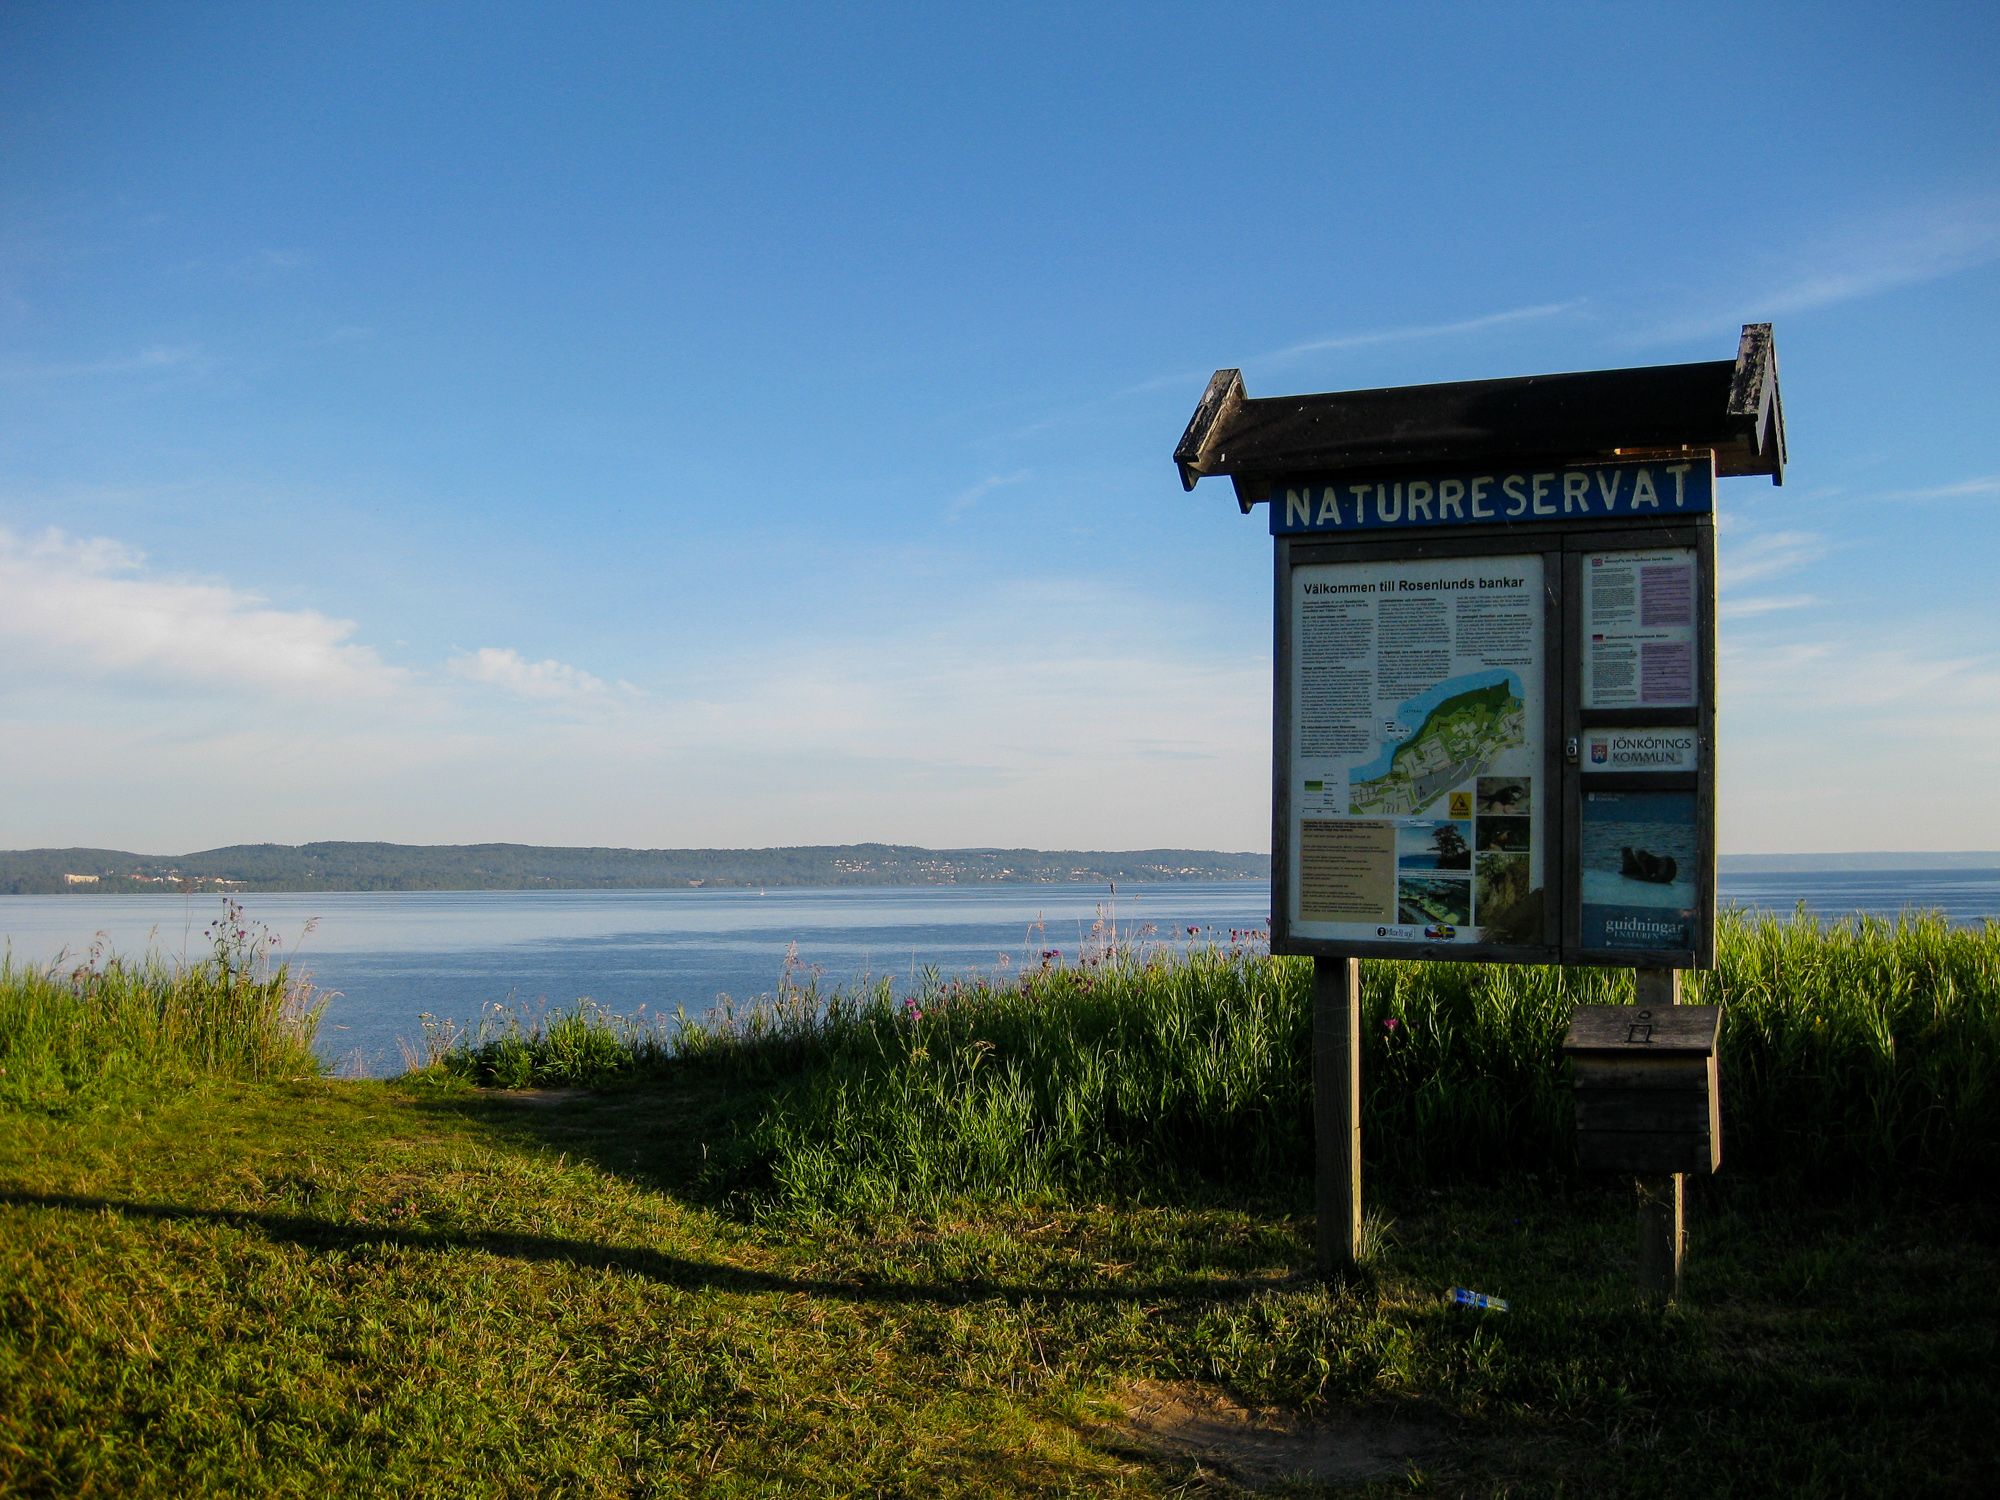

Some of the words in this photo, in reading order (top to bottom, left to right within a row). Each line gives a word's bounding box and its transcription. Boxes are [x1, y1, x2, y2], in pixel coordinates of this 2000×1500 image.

[1286, 464, 1691, 526] NATURRESERVAT
[1304, 583, 1375, 594] Välkommen
[1380, 580, 1395, 592] till
[1399, 578, 1475, 592] Rosenlunds
[1479, 577, 1524, 589] bankar
[1612, 736, 1691, 750] JÖNKÖPINGS
[1613, 752, 1675, 762] KOMMUN
[1605, 917, 1684, 935] guidningar
